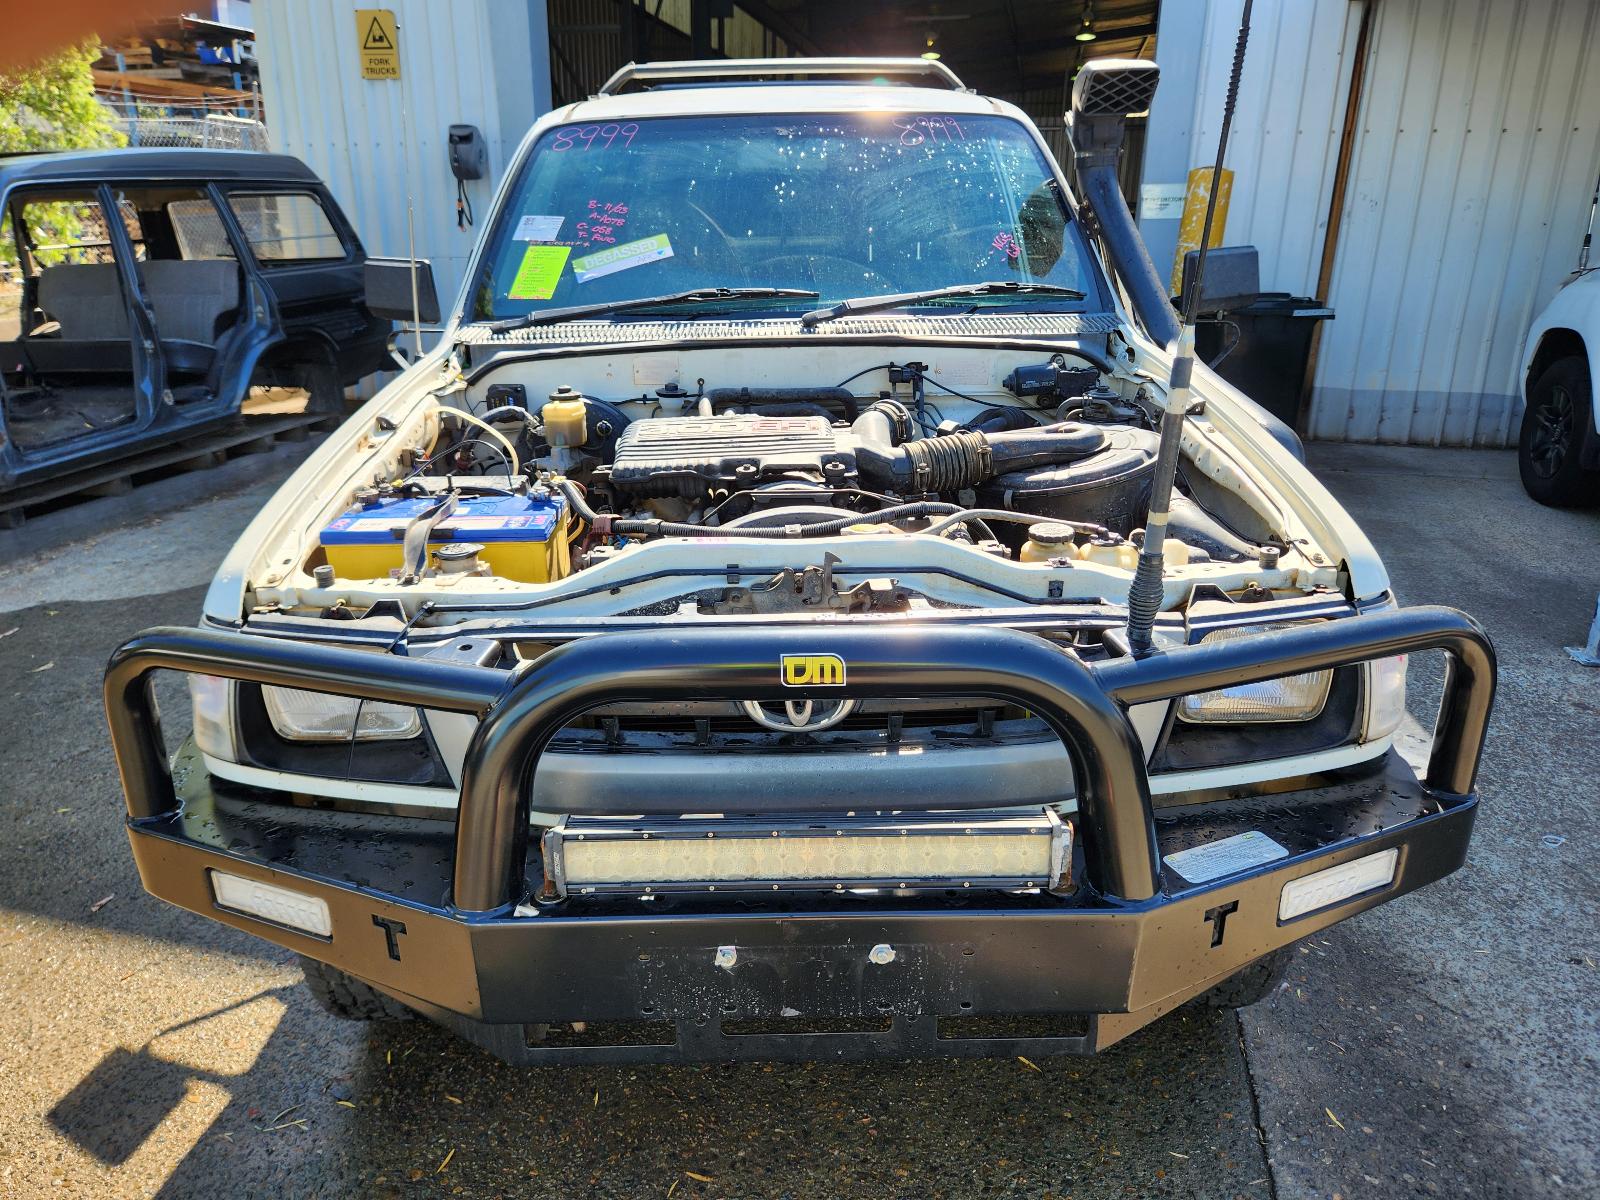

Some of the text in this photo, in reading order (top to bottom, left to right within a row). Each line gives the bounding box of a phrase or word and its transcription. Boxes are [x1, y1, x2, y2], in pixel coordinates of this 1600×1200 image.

[365, 67, 397, 75] TRUCKS
[368, 58, 391, 66] FORK
[552, 123, 639, 152] 8999
[892, 116, 965, 146] 8999
[585, 240, 657, 269] DEGASSED
[783, 656, 843, 684] TJM
